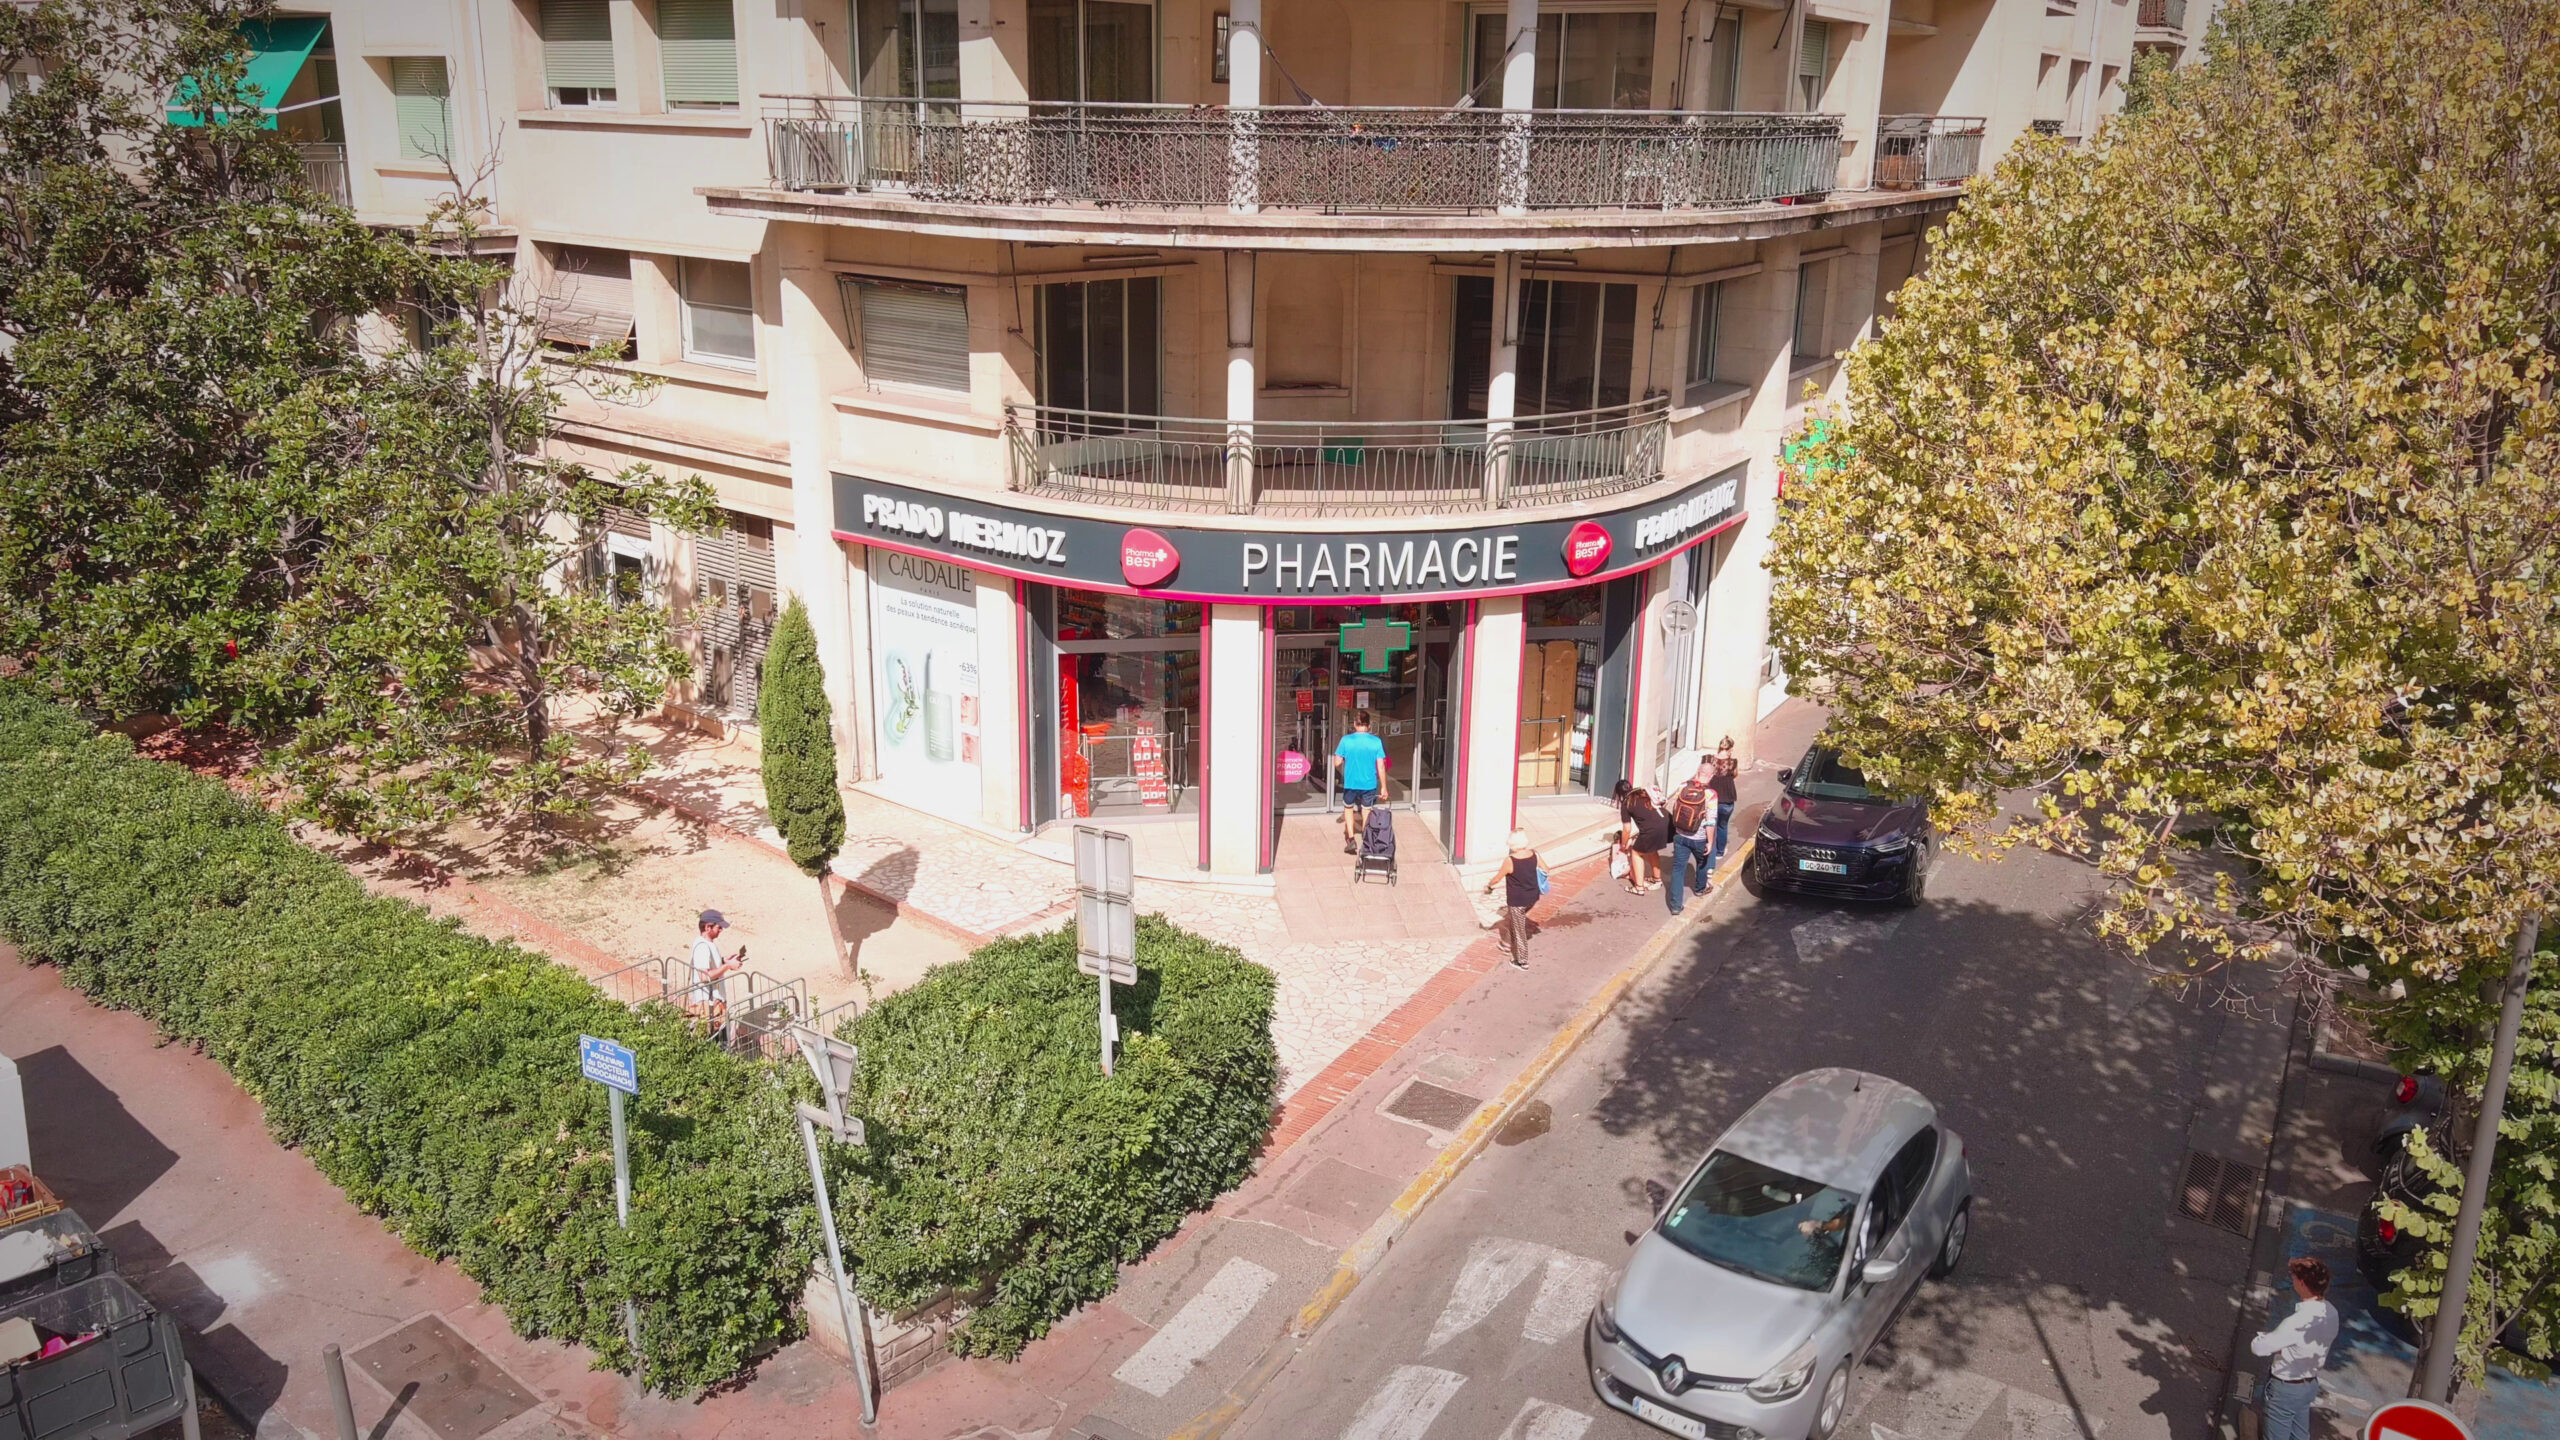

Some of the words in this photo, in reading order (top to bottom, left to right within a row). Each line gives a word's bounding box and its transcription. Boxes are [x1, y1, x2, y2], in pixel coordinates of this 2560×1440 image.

[863, 494, 944, 538] PRADO
[949, 511, 1067, 562] MERMOZ
[1126, 548, 1155, 557] Pharma
[1243, 535, 1519, 588] PHARMACIE
[888, 553, 972, 593] CAUDALIE
[886, 604, 896, 613] des
[897, 607, 915, 618] peaux
[921, 613, 948, 627] tendance
[908, 598, 933, 612] solution
[933, 605, 960, 619] naturelle
[1276, 762, 1304, 770] PRADO
[587, 1058, 596, 1066] du
[597, 1061, 630, 1078] DOCTEUR
[590, 1051, 625, 1068] BOULEVARD
[586, 1065, 633, 1087] RODOCANACHI
